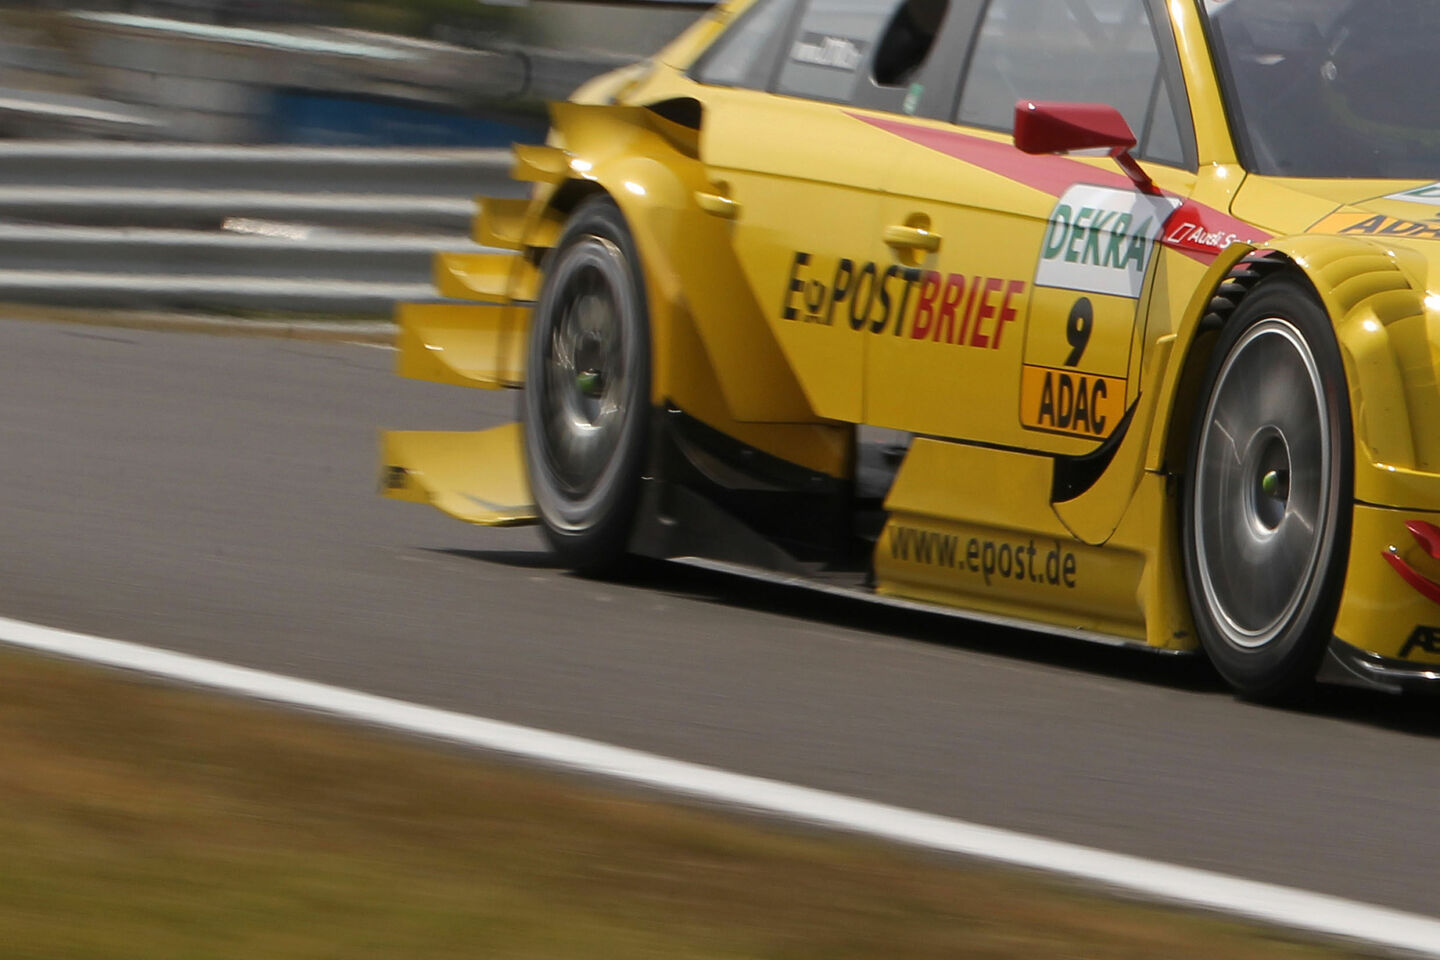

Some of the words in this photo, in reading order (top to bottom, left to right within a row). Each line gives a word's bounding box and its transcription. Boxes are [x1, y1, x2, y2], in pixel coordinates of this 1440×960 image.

[1043, 203, 1154, 273] DEKRA
[1187, 225, 1225, 247] Audi
[1062, 296, 1094, 368] 9
[1037, 370, 1107, 436] ADAC
[887, 525, 1077, 589] www.epost.de
